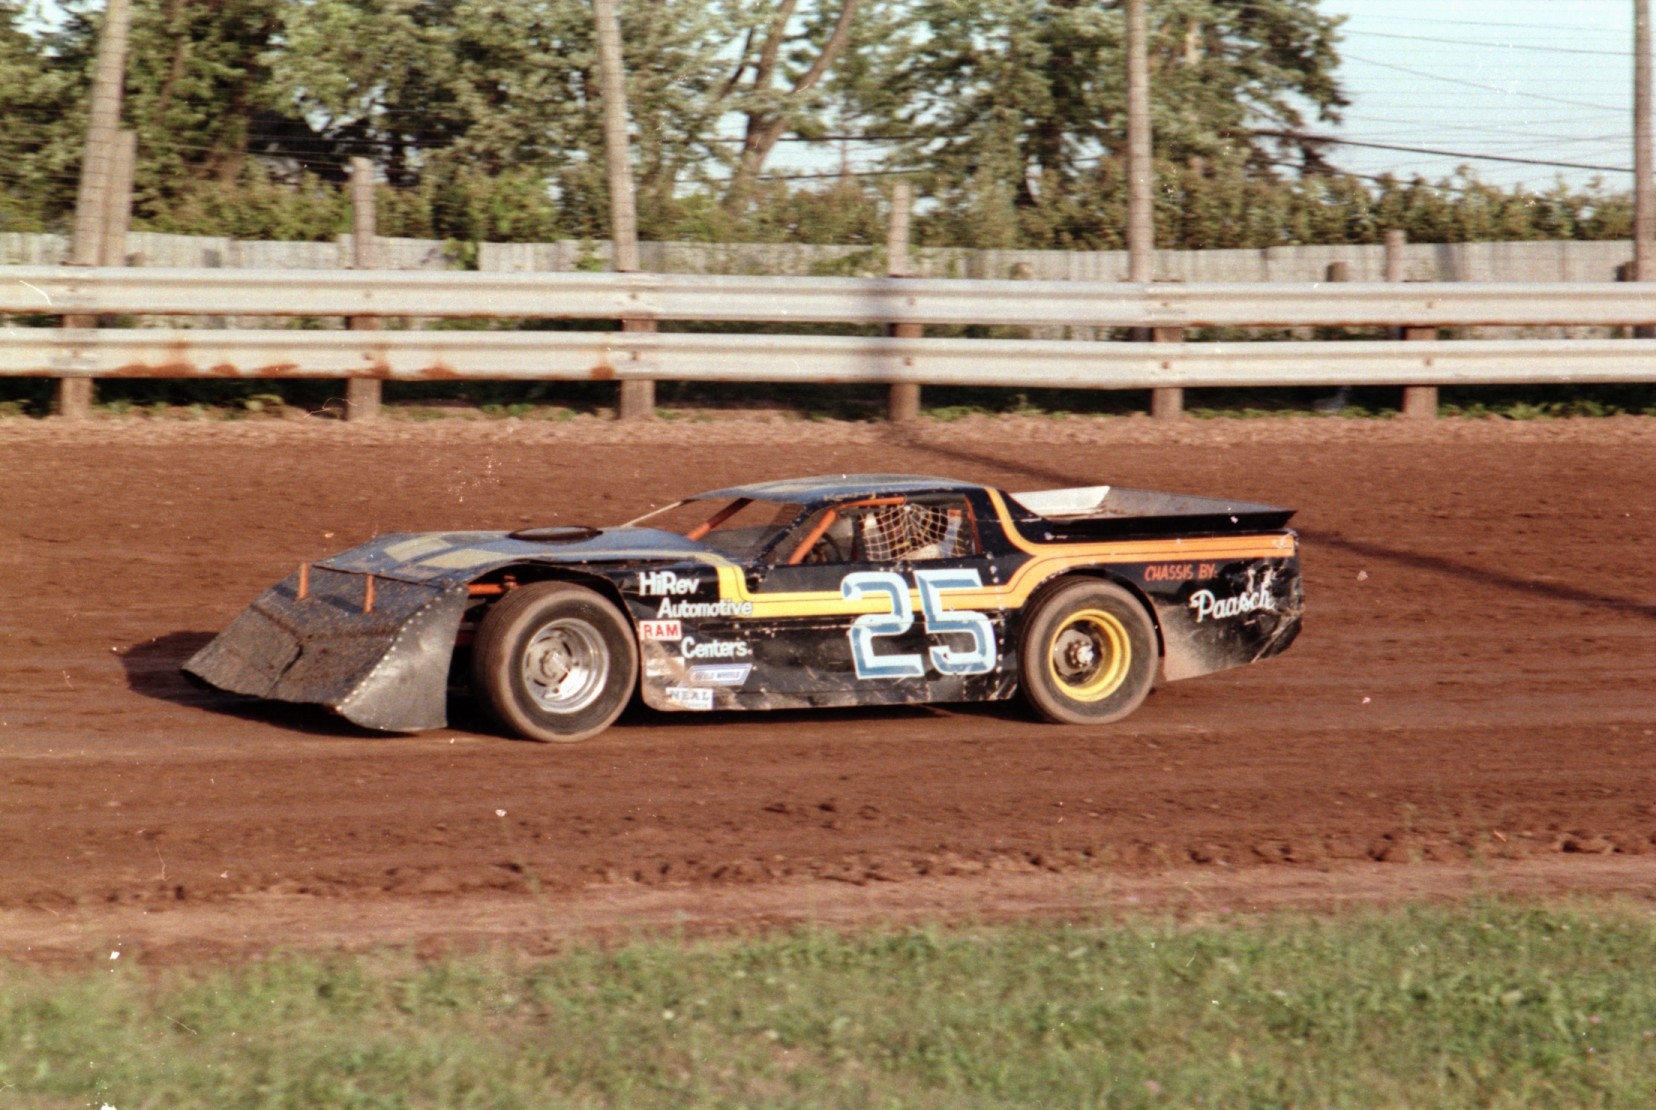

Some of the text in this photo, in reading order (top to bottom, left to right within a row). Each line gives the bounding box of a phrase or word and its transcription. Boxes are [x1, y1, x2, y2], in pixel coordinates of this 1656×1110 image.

[639, 571, 700, 596] HiRev
[1144, 564, 1194, 581] CHASSIS
[657, 597, 753, 619] Automotive
[1189, 588, 1276, 623] Paasch
[643, 624, 679, 637] RAM
[840, 568, 996, 680] 25
[681, 636, 748, 658] Centers
